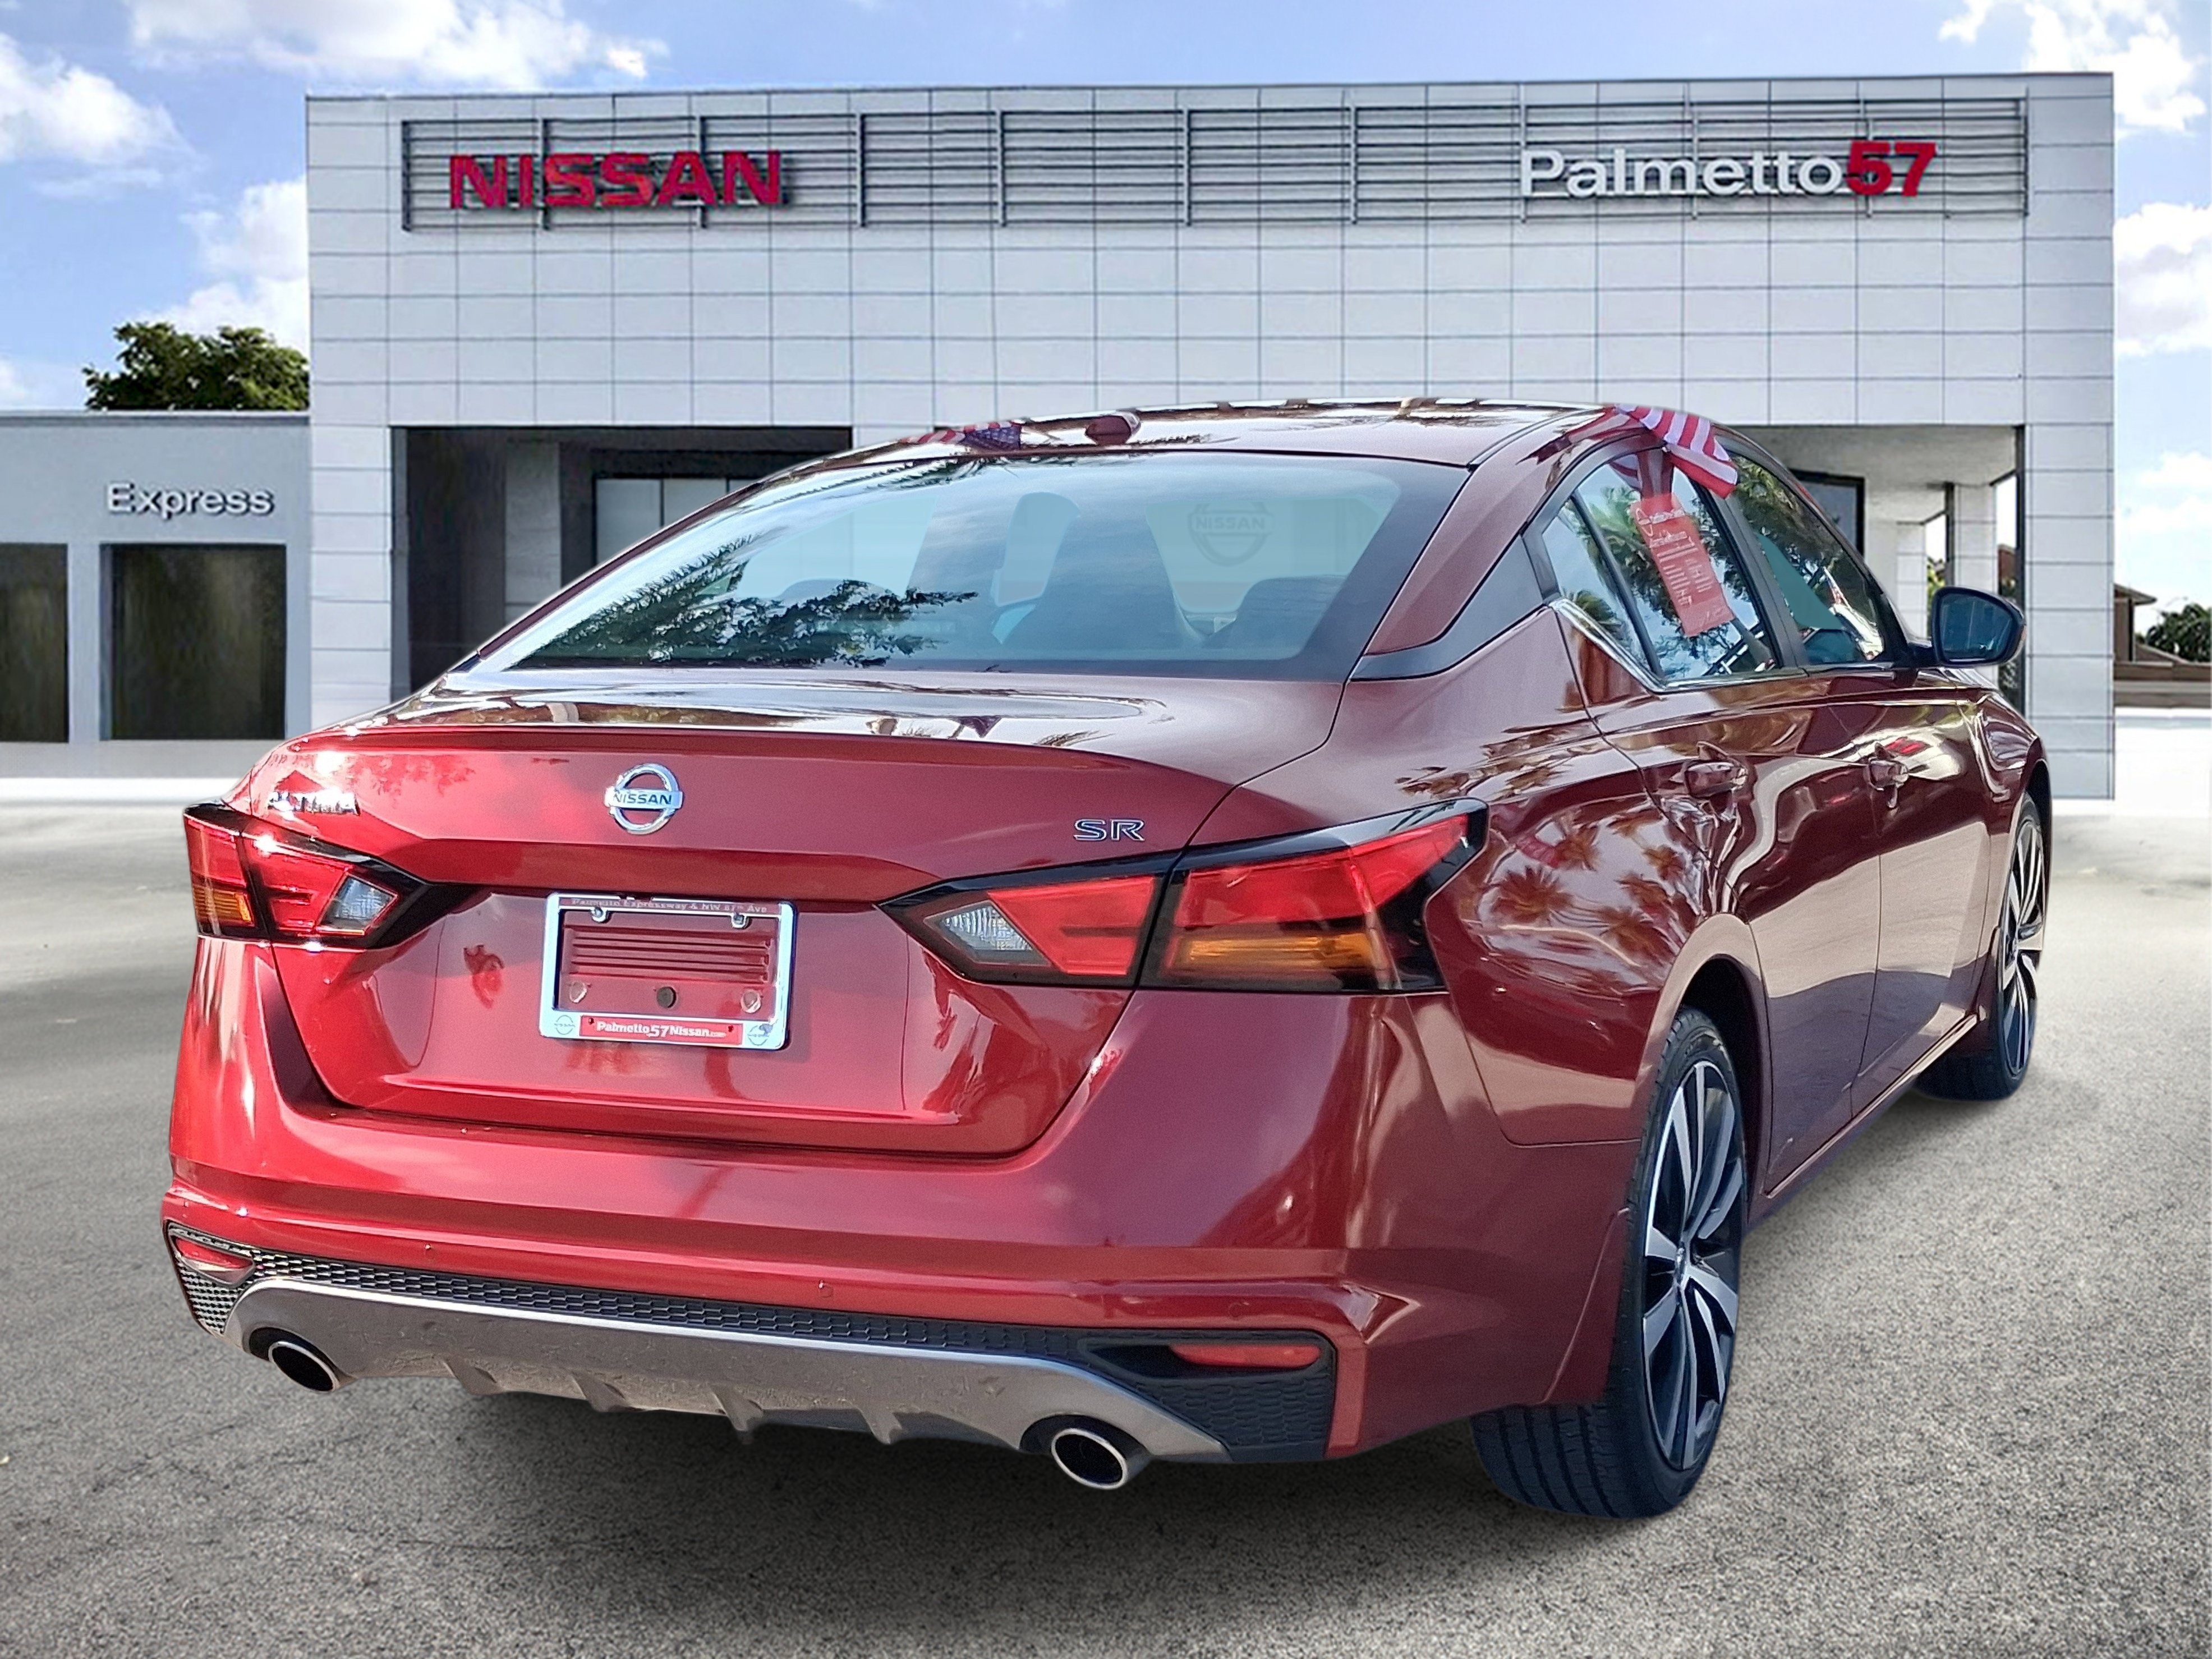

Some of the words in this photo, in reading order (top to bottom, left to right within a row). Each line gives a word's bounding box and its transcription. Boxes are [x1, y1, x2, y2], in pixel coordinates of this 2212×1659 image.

[450, 150, 781, 209] NISSAN
[108, 482, 275, 521] Express
[1195, 516, 1265, 530] NISSAN
[614, 793, 672, 805] NISSAN
[1073, 819, 1146, 842] SR
[746, 904, 767, 913] Ave
